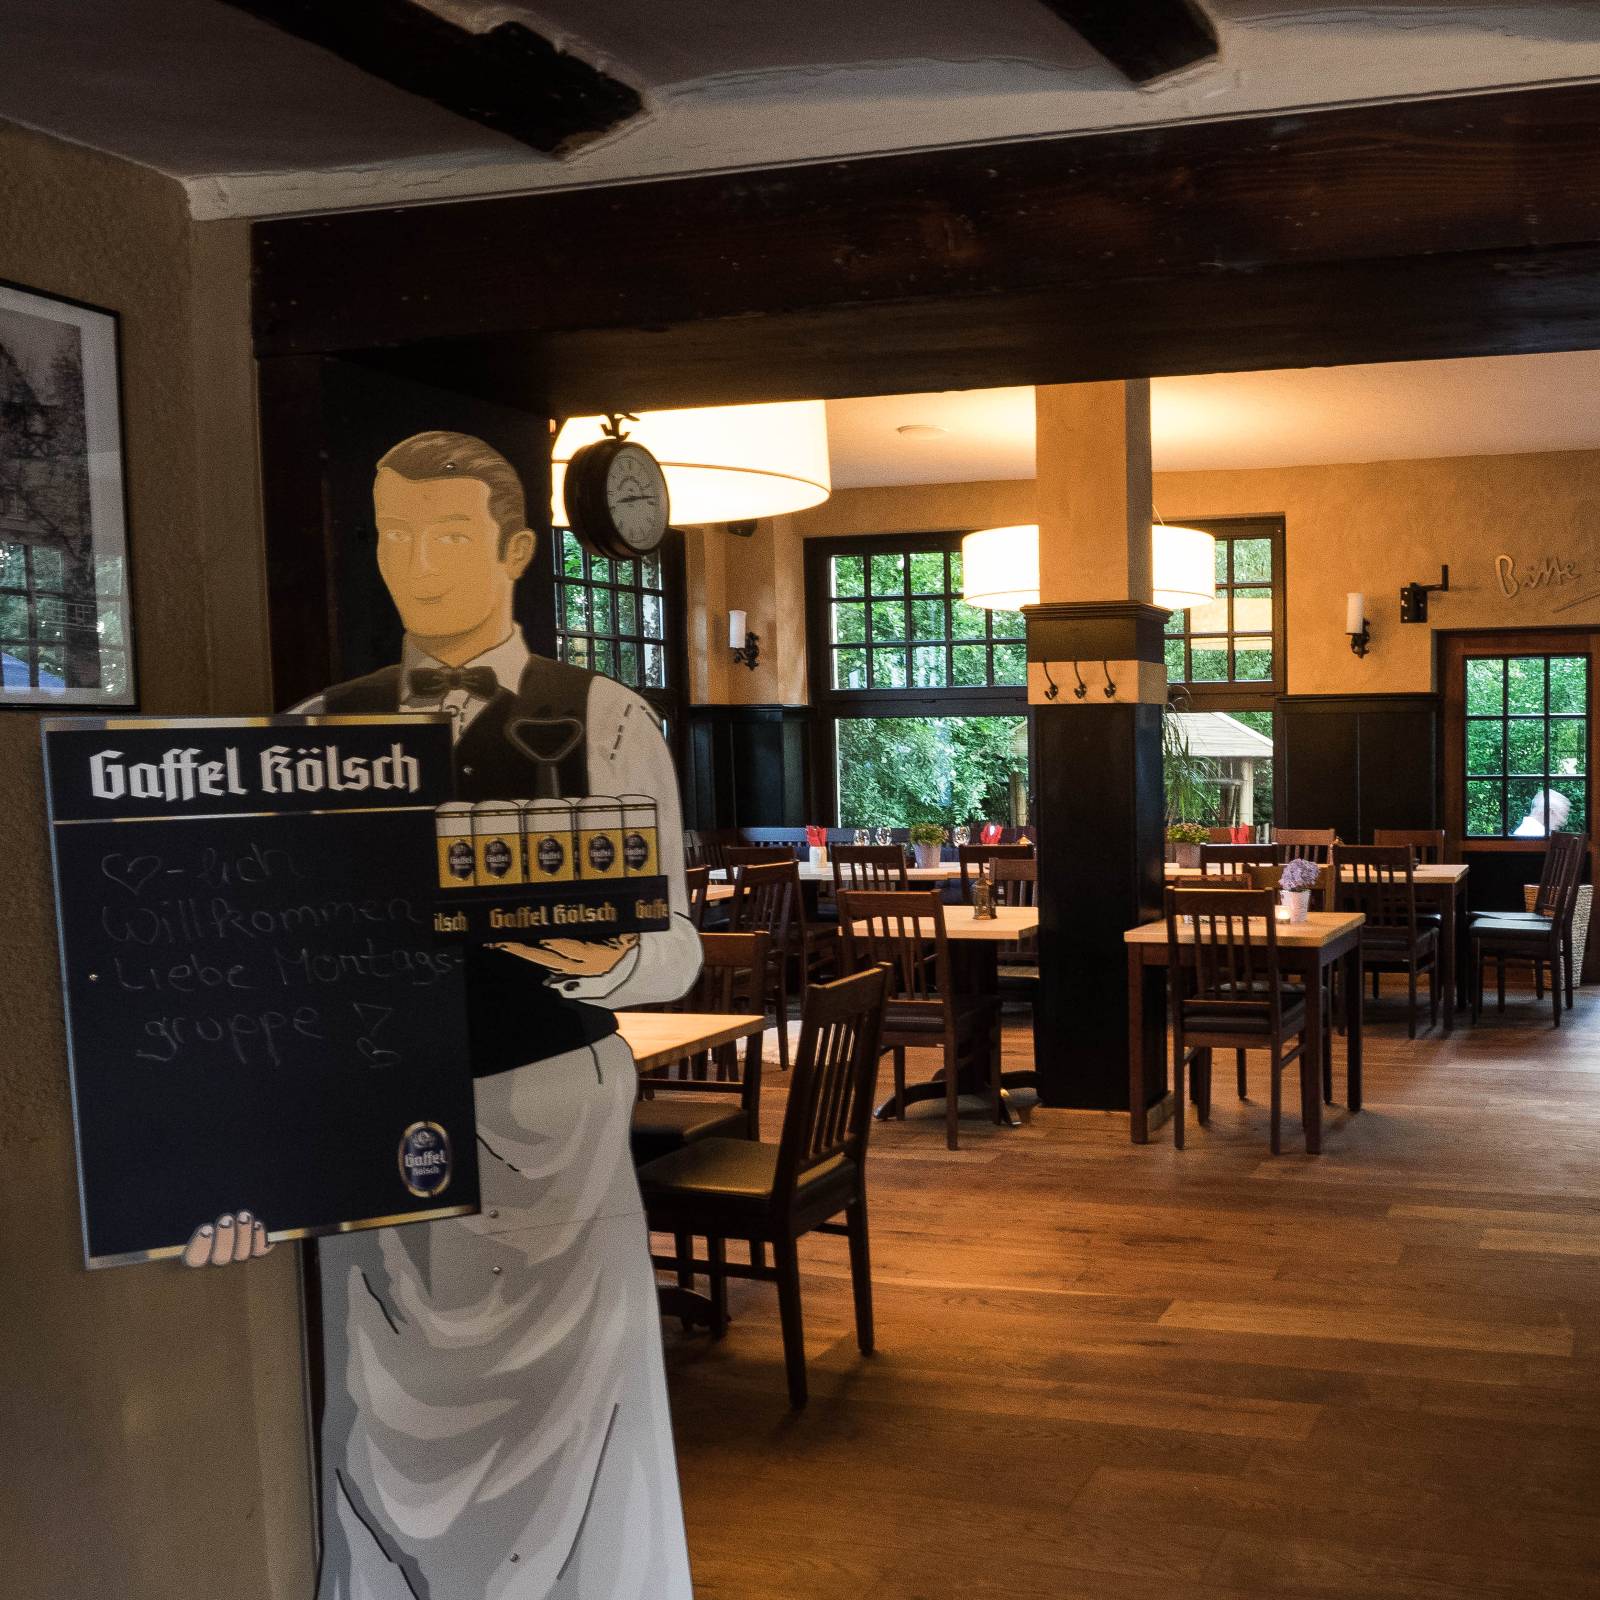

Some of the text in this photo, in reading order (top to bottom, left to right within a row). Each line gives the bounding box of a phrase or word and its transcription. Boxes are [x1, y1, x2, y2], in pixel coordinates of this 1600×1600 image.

[89, 742, 422, 802] Gaffel Kölsch
[489, 900, 619, 929] Gaffel Kölsch
[404, 1148, 448, 1168] Gaffel
